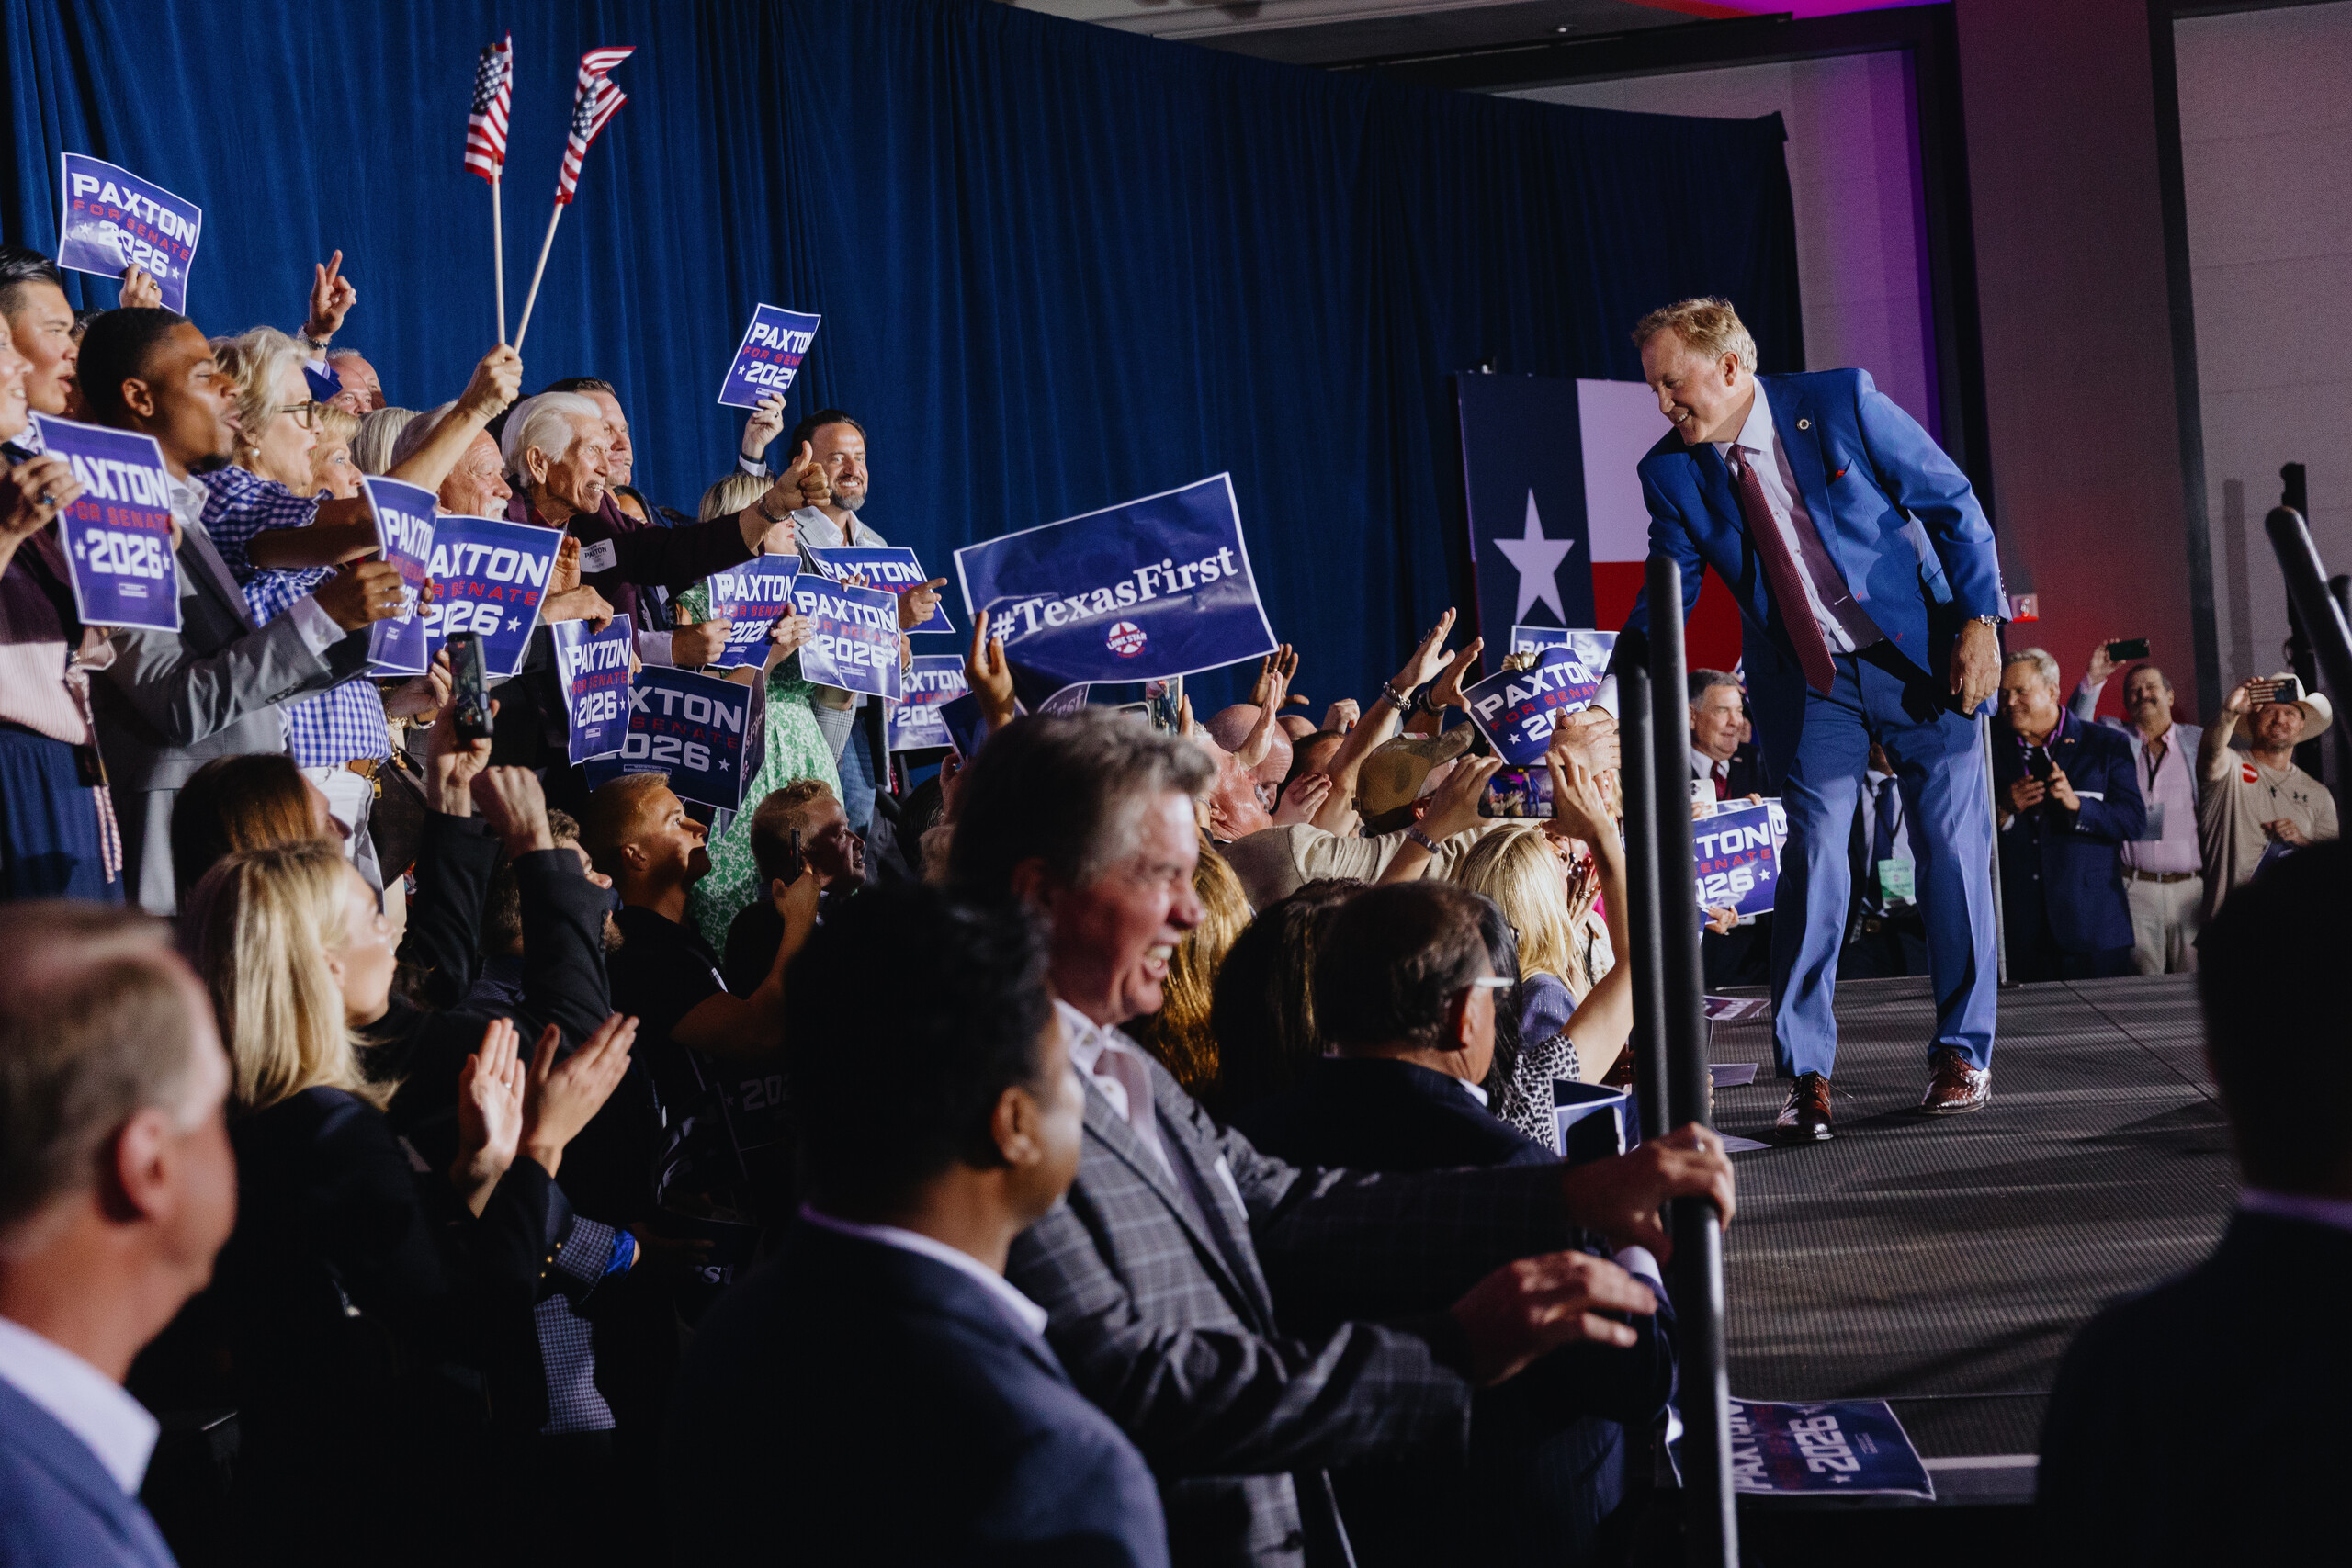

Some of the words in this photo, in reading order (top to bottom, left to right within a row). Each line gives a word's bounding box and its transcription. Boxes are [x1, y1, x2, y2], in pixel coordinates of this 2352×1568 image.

[71, 173, 196, 247] PAXTON
[74, 200, 120, 220] FOR
[127, 218, 189, 261] SENATE
[97, 220, 169, 277] 2026
[742, 345, 769, 360] FOR
[744, 361, 797, 389] 202
[86, 528, 164, 579] 2026
[426, 543, 549, 587] AXTON
[816, 558, 923, 582] PAXTON
[714, 574, 797, 601] PAXTON
[992, 547, 1238, 642] #TexasFirst
[793, 591, 898, 634] PAXTON
[818, 634, 888, 670] 2026
[1126, 631, 1147, 643] STAR
[564, 637, 630, 677] PAXTON
[572, 678, 587, 694] FOR
[902, 670, 966, 692] AXTON
[1474, 661, 1600, 722] PAXTON
[577, 691, 617, 728] 2026
[628, 686, 742, 734] XTON
[897, 704, 943, 728] 202
[1490, 704, 1536, 731] FOR
[1544, 685, 1597, 705] SENAT
[632, 716, 739, 749] SENATE
[589, 733, 710, 772] 026
[1695, 848, 1771, 874] ENATE
[1695, 866, 1755, 903] 026
[1789, 1415, 1861, 1472] 2026
